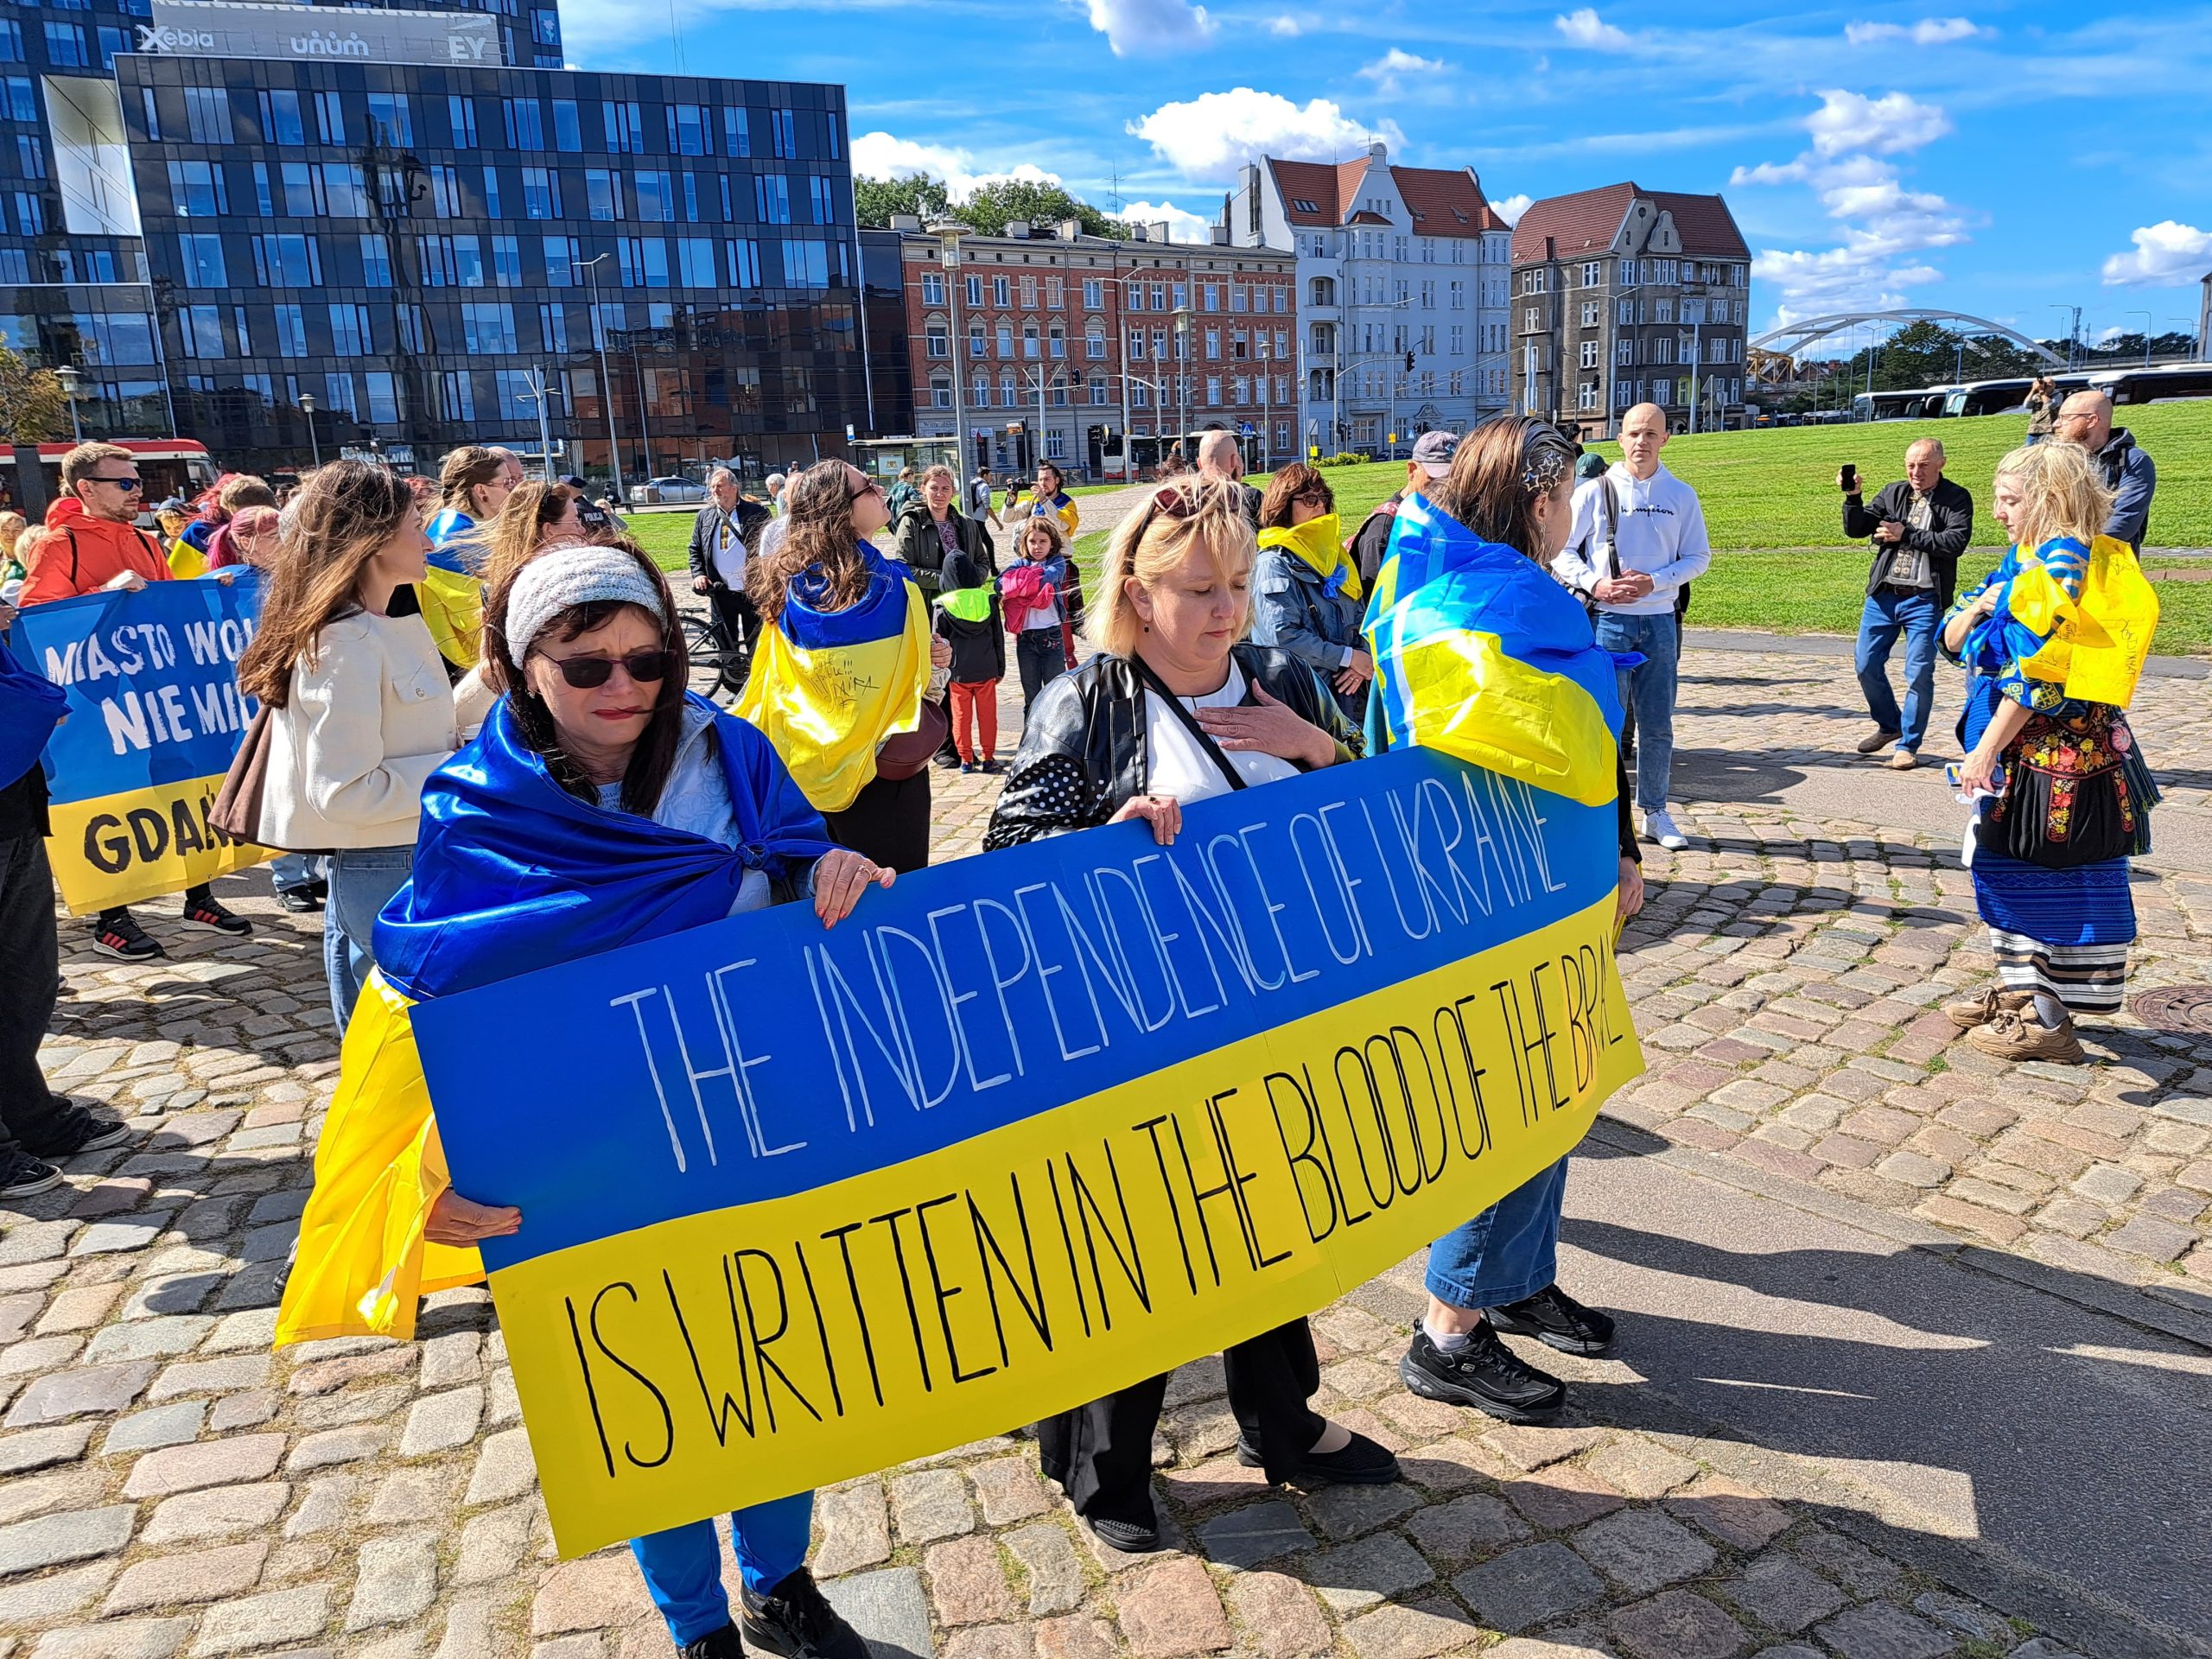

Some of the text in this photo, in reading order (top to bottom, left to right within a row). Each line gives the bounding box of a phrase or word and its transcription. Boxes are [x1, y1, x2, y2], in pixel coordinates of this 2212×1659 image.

[136, 24, 214, 51] Xebia
[448, 35, 486, 60] EY
[45, 623, 176, 687] MIASTO
[100, 683, 194, 755] NIE
[83, 783, 247, 874] GDAŃ
[610, 767, 1567, 1173] THE INDEPENDENCE OF UKRAINE
[564, 1281, 674, 1478] IS
[662, 1171, 1054, 1447] WRITTEN
[1046, 1137, 1153, 1338] IN
[1131, 1087, 1293, 1296] THE
[1263, 1026, 1448, 1244] BLOOD
[1433, 995, 1492, 1160] OF
[1490, 961, 1571, 1128] THE
